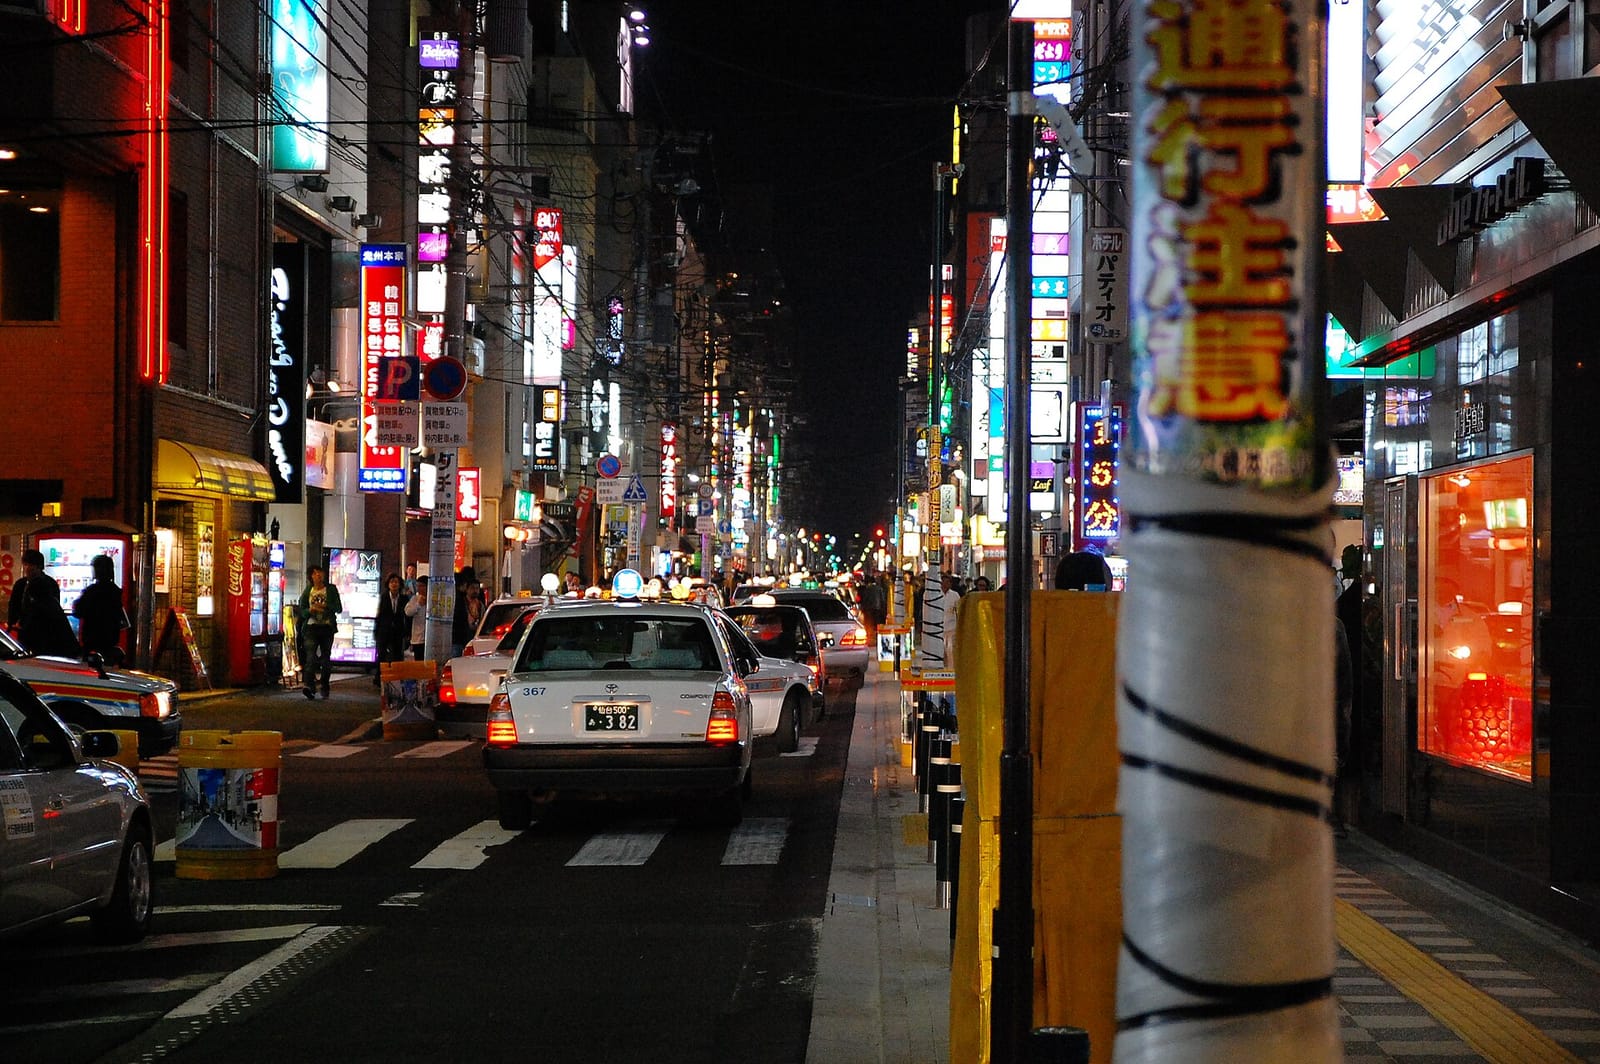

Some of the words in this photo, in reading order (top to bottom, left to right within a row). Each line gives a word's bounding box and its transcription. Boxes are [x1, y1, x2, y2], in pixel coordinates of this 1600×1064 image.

[1092, 234, 1121, 251] ホテル
[1096, 255, 1118, 321] パティオ
[523, 687, 546, 696] 367
